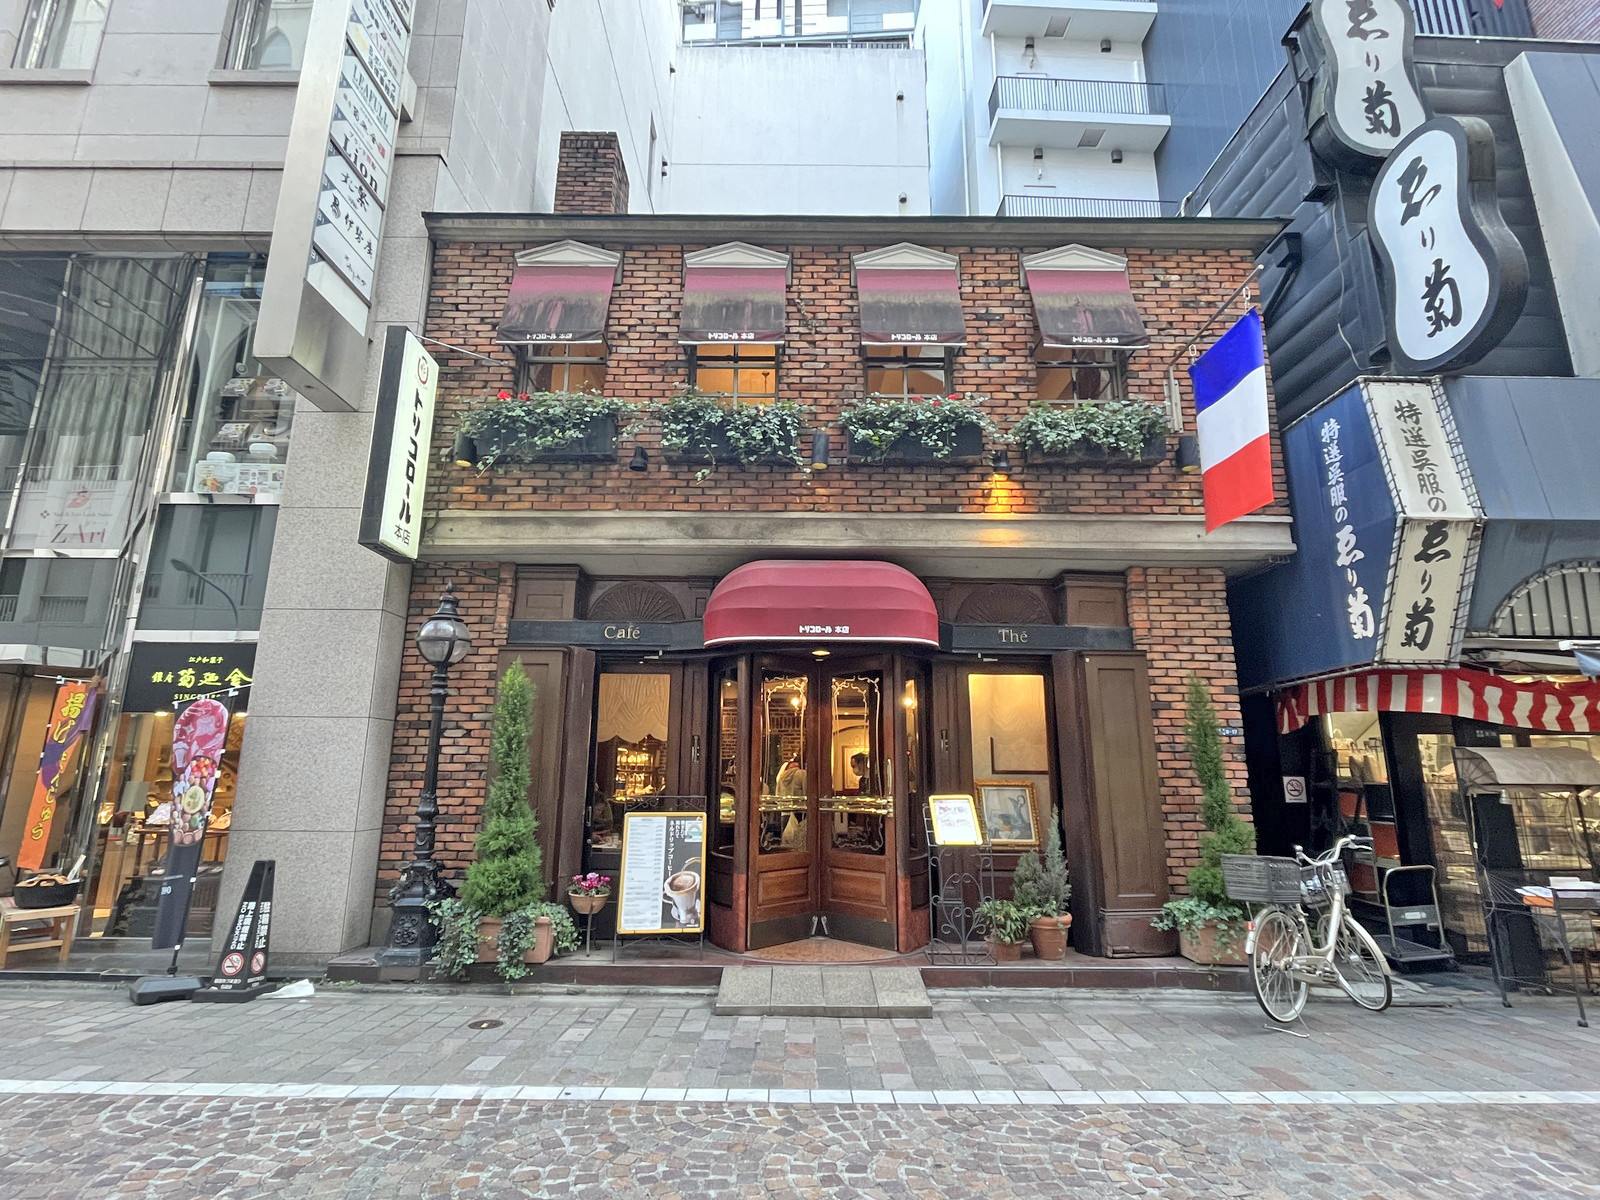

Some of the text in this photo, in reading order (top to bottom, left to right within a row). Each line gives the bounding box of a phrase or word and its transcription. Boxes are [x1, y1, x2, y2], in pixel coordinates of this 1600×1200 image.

[353, 64, 388, 128] LEAFULL
[343, 132, 378, 194] Lion
[708, 332, 739, 340] トリコロール
[891, 333, 921, 341] トリコロール
[1072, 336, 1103, 344] トリコロール
[399, 388, 423, 525] トリコロール
[394, 524, 411, 546] 本店
[604, 624, 640, 639] Café
[799, 625, 850, 634] トリコロール 本店
[998, 629, 1028, 643] Thé
[188, 656, 224, 665] 江戸和菓子
[667, 820, 675, 877] ネルドリップコーヒー
